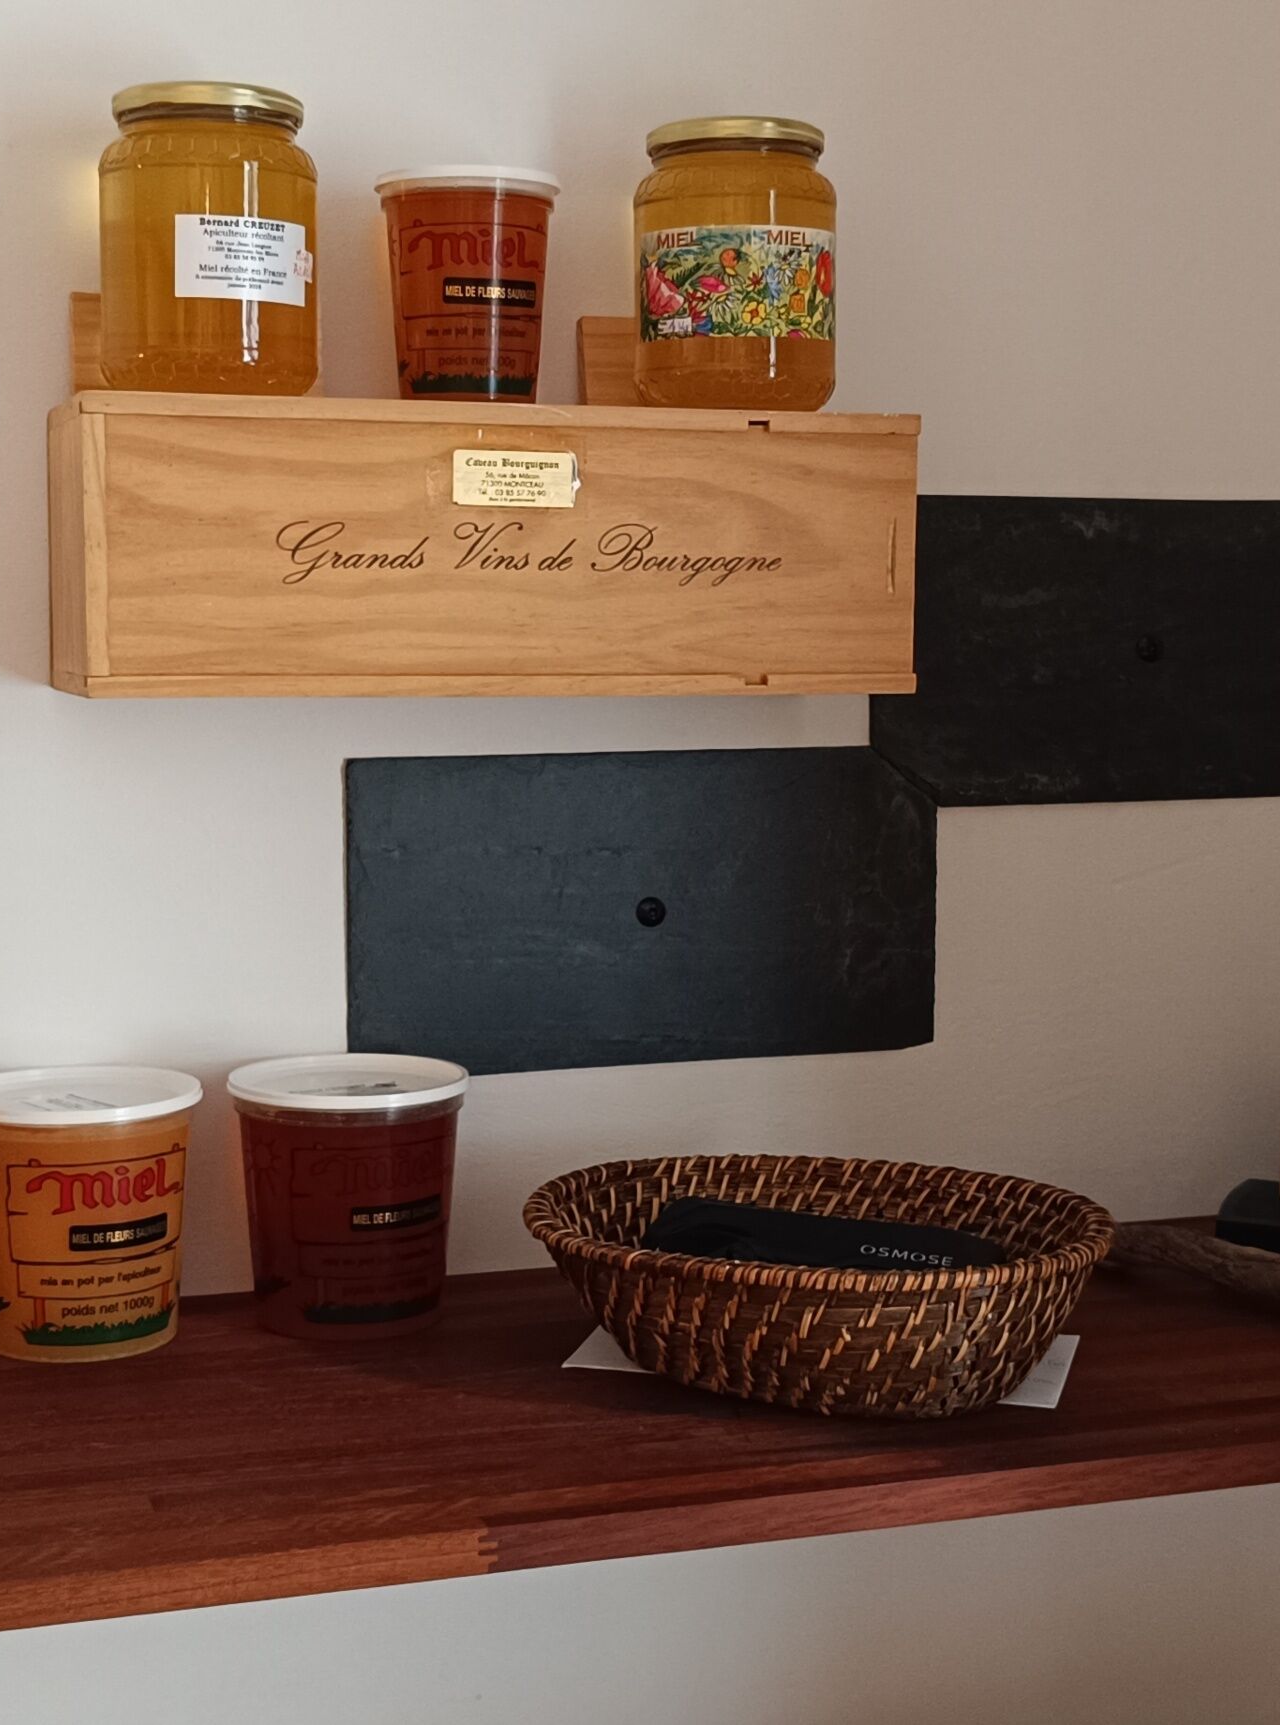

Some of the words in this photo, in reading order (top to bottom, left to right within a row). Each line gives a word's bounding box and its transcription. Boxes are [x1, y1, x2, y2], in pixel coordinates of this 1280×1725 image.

[199, 217, 240, 228] Bernard
[203, 228, 249, 238] Apiculteur
[252, 232, 285, 242] récoltant
[656, 231, 701, 250] MIEL
[766, 230, 814, 248] MIEL
[199, 264, 218, 272] Miel
[220, 265, 249, 274] récolté
[251, 268, 261, 276] en
[263, 268, 287, 278] France
[445, 285, 463, 297] MIEL
[465, 286, 476, 297] DE
[478, 286, 506, 299] FLEURS
[502, 458, 560, 470] Bourguignon
[504, 480, 544, 488] MONTCEAU
[276, 520, 430, 585] Grands
[453, 521, 530, 572] Vins
[538, 537, 577, 573] de
[590, 522, 784, 587] Bourgogne
[353, 1214, 371, 1225] MIEL
[373, 1213, 384, 1224] DE
[72, 1230, 92, 1244] MIEL
[93, 1230, 105, 1244] DE
[106, 1227, 135, 1244] FLEURS
[860, 1243, 955, 1268] OSMOSE
[77, 1276, 95, 1288] pot
[98, 1274, 115, 1287] par
[62, 1304, 96, 1319] poids
[99, 1302, 120, 1314] net
[123, 1295, 156, 1311] 1000g
